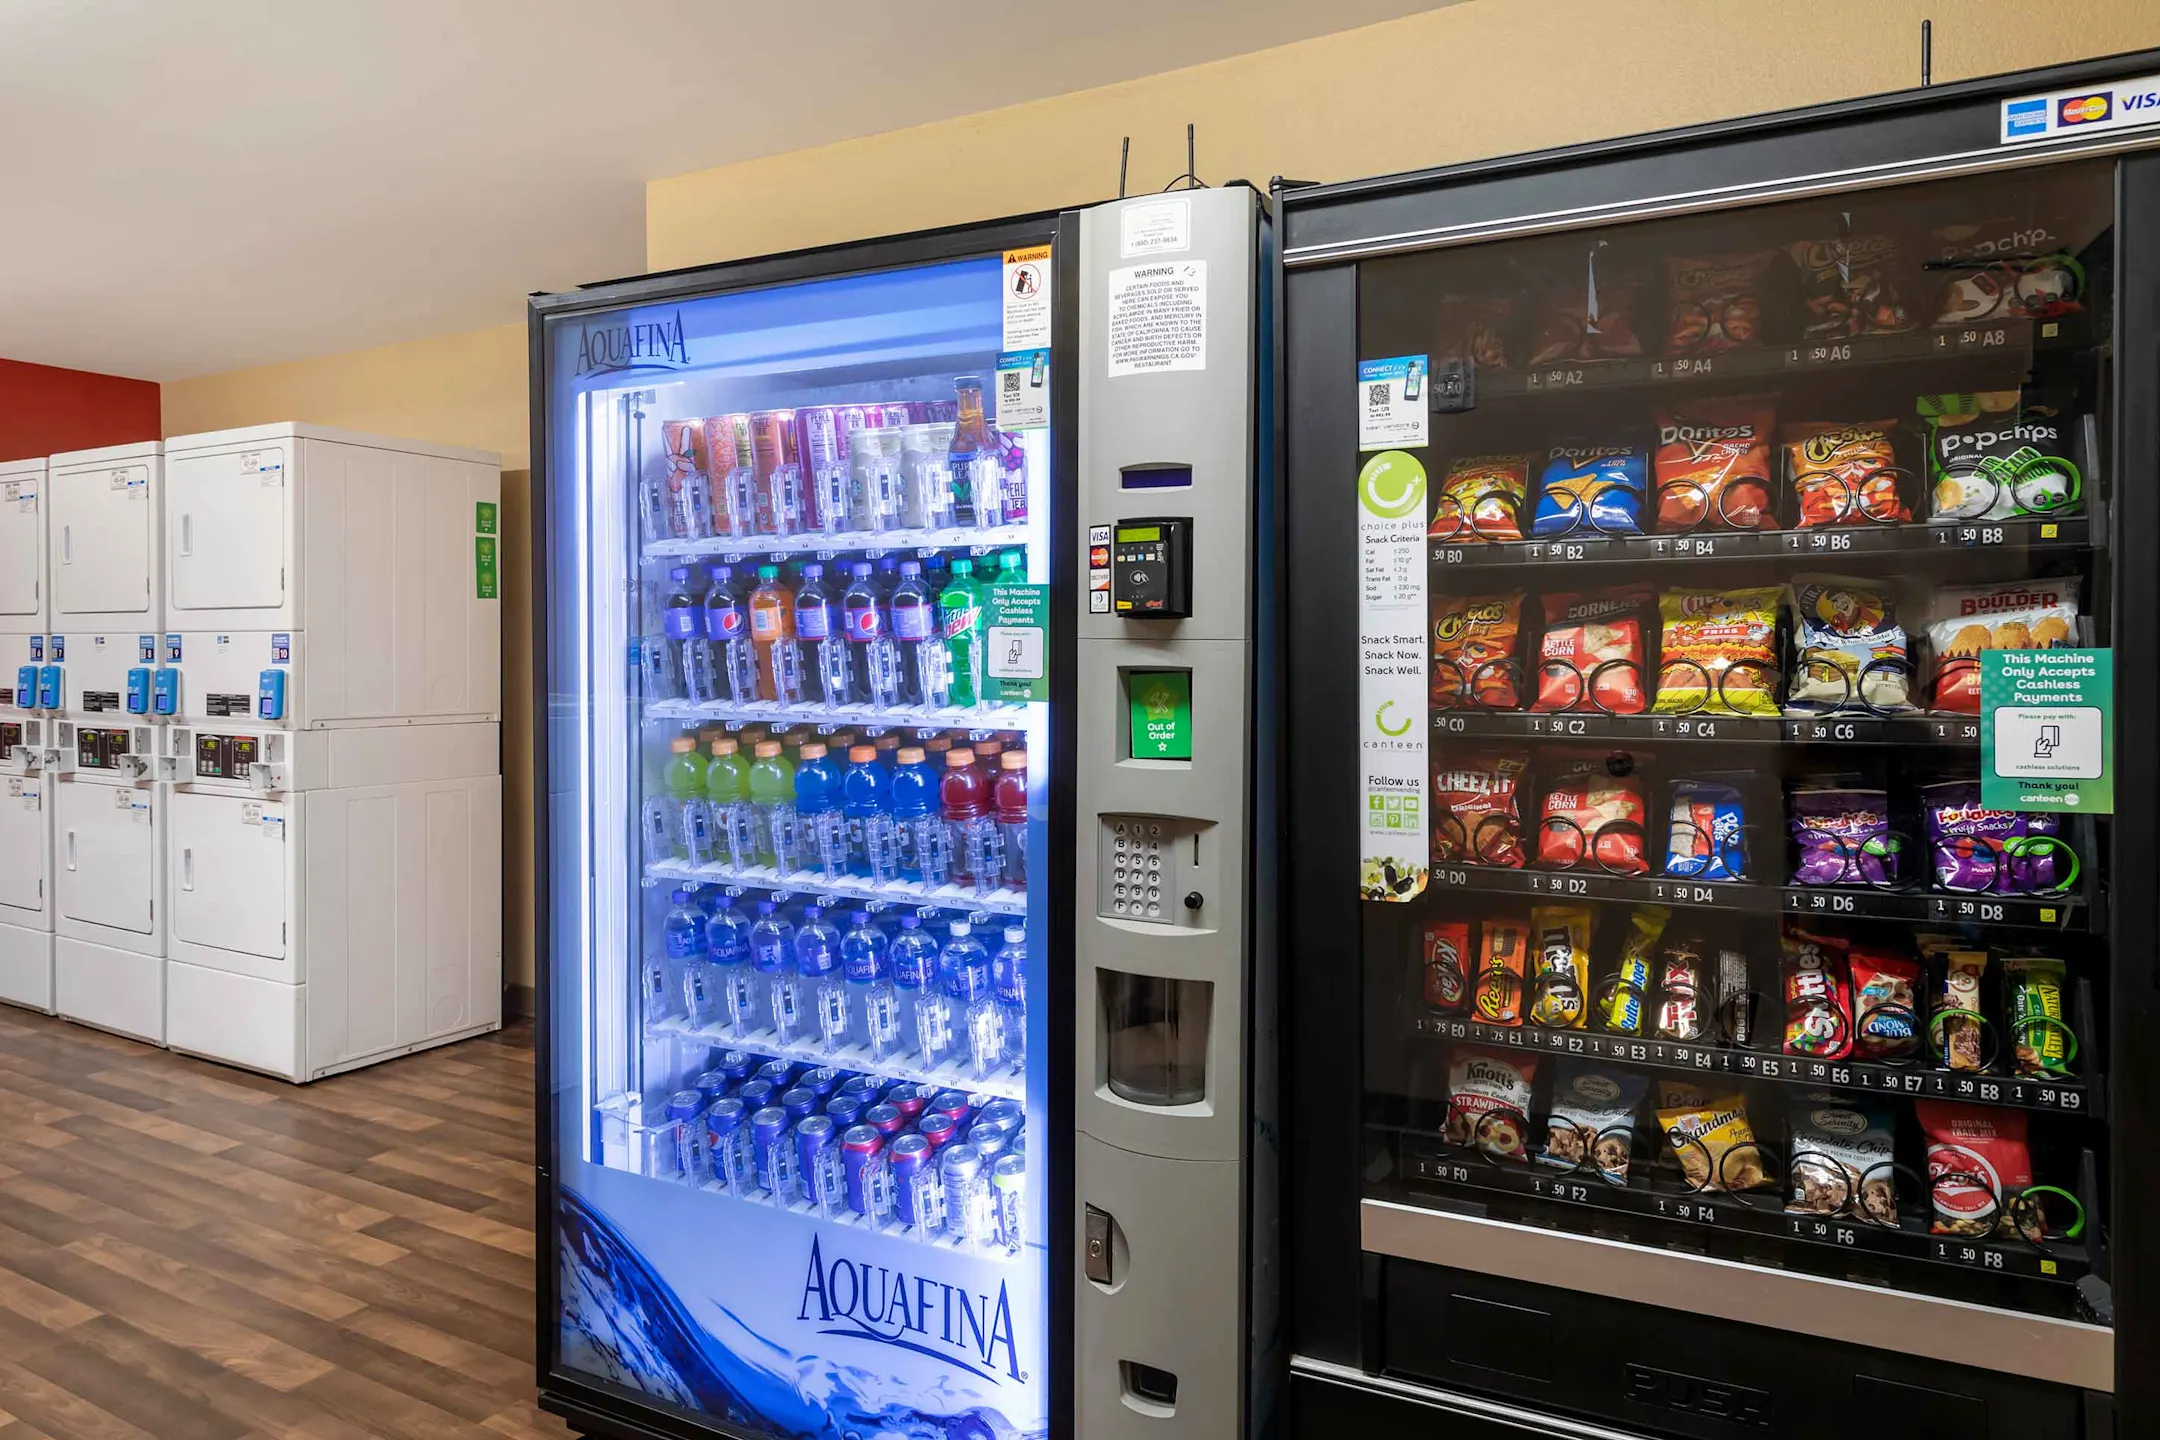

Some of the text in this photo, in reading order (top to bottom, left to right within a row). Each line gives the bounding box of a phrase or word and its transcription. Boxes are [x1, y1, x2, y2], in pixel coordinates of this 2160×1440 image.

[1017, 252, 1048, 262] WARNING
[1134, 267, 1174, 278] WARNING
[575, 308, 690, 378] AQUAFINA
[1983, 330, 2005, 347] A8
[1830, 345, 1851, 361] A6
[1363, 364, 1394, 375] CONNECT
[1693, 359, 1713, 375] A4
[1565, 371, 1583, 386] A2
[1661, 425, 1753, 444] Doritos
[1941, 424, 2058, 458] popchips
[1361, 521, 1424, 532] choice plus
[1092, 531, 1109, 542] VISA
[1366, 534, 1420, 544] Snack Criteria
[1831, 534, 1850, 550] B6
[1982, 528, 2004, 544] B8
[1567, 545, 1583, 560] B2
[1696, 540, 1714, 555] B4
[993, 588, 1041, 596] This Machine
[992, 597, 1041, 606] Only Accepts
[1960, 592, 2059, 616] BOULDER
[1000, 606, 1034, 615] Cashless
[998, 616, 1034, 625] Payments
[1703, 627, 1739, 636] FRIES
[1361, 635, 1425, 645] Snack Smart.
[1544, 638, 1575, 648] KETTLE
[1365, 650, 1422, 660] Snack Now.
[1544, 647, 1575, 657] CORN
[2002, 653, 2095, 664] This Machine
[1365, 665, 1422, 675] Snack Well.
[2001, 666, 2096, 679] Only Accepts
[2016, 679, 2081, 690] Cashless
[2014, 692, 2083, 704] Payments
[1147, 722, 1175, 731] Out of
[1568, 720, 1585, 734] C2
[1697, 722, 1716, 737] C4
[1834, 724, 1855, 740] C6
[1148, 731, 1175, 740] Order
[1363, 740, 1422, 749] canteen
[1368, 775, 1419, 786] Follow us
[2018, 781, 2079, 791] Thank you!
[1549, 793, 1579, 801] KETTLE
[2020, 794, 2063, 803] canteen
[1548, 800, 1577, 810] CORN
[1977, 821, 2008, 833] Snacks
[1118, 840, 1125, 848] B
[1152, 858, 1157, 866] 6
[1569, 879, 1587, 894] D2
[1693, 888, 1714, 902] D4
[1833, 896, 1854, 911] D6
[1980, 904, 2004, 920] D8
[1451, 1024, 1465, 1038] E0
[1509, 1031, 1523, 1045] E1
[1569, 1038, 1583, 1052] E2
[1631, 1046, 1646, 1060] E3
[1695, 1053, 1712, 1068] E4
[1762, 1061, 1779, 1076] E5
[1832, 1067, 1850, 1084] E6
[1466, 1062, 1515, 1091] Knott's
[1904, 1075, 1923, 1092] E7
[1980, 1083, 1999, 1100] E8
[2060, 1092, 2080, 1109] E9
[1951, 1119, 1994, 1129] ORIGINAL
[1979, 1128, 1997, 1137] MIX
[1856, 1140, 1894, 1155] Chip
[1453, 1167, 1468, 1182] F0
[1572, 1186, 1587, 1201] F2
[1698, 1207, 1714, 1222] F4
[1837, 1228, 1855, 1245] F6
[1984, 1251, 2003, 1269] F8
[796, 1231, 1026, 1385] AQUAFINA
